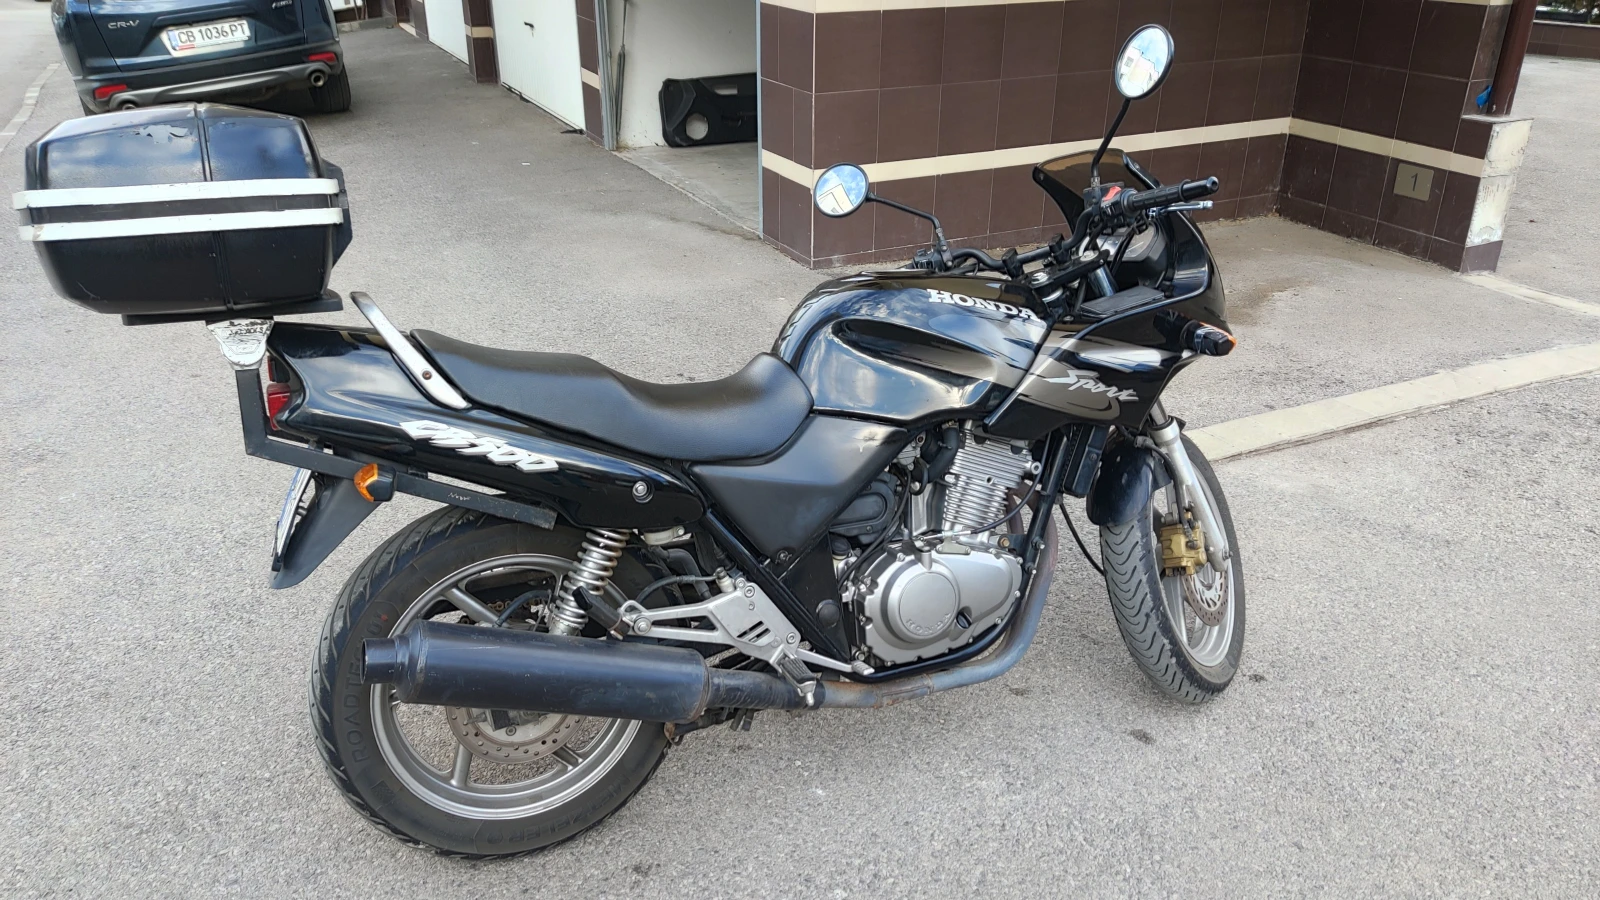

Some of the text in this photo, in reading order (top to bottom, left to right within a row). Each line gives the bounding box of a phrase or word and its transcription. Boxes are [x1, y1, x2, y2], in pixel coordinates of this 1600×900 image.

[107, 20, 140, 29] CR-V
[177, 22, 246, 44] CB 1036 PT
[1410, 172, 1419, 192] 1
[926, 288, 1041, 322] HONDA
[1042, 369, 1139, 403] Sport
[905, 612, 952, 635] HONDA
